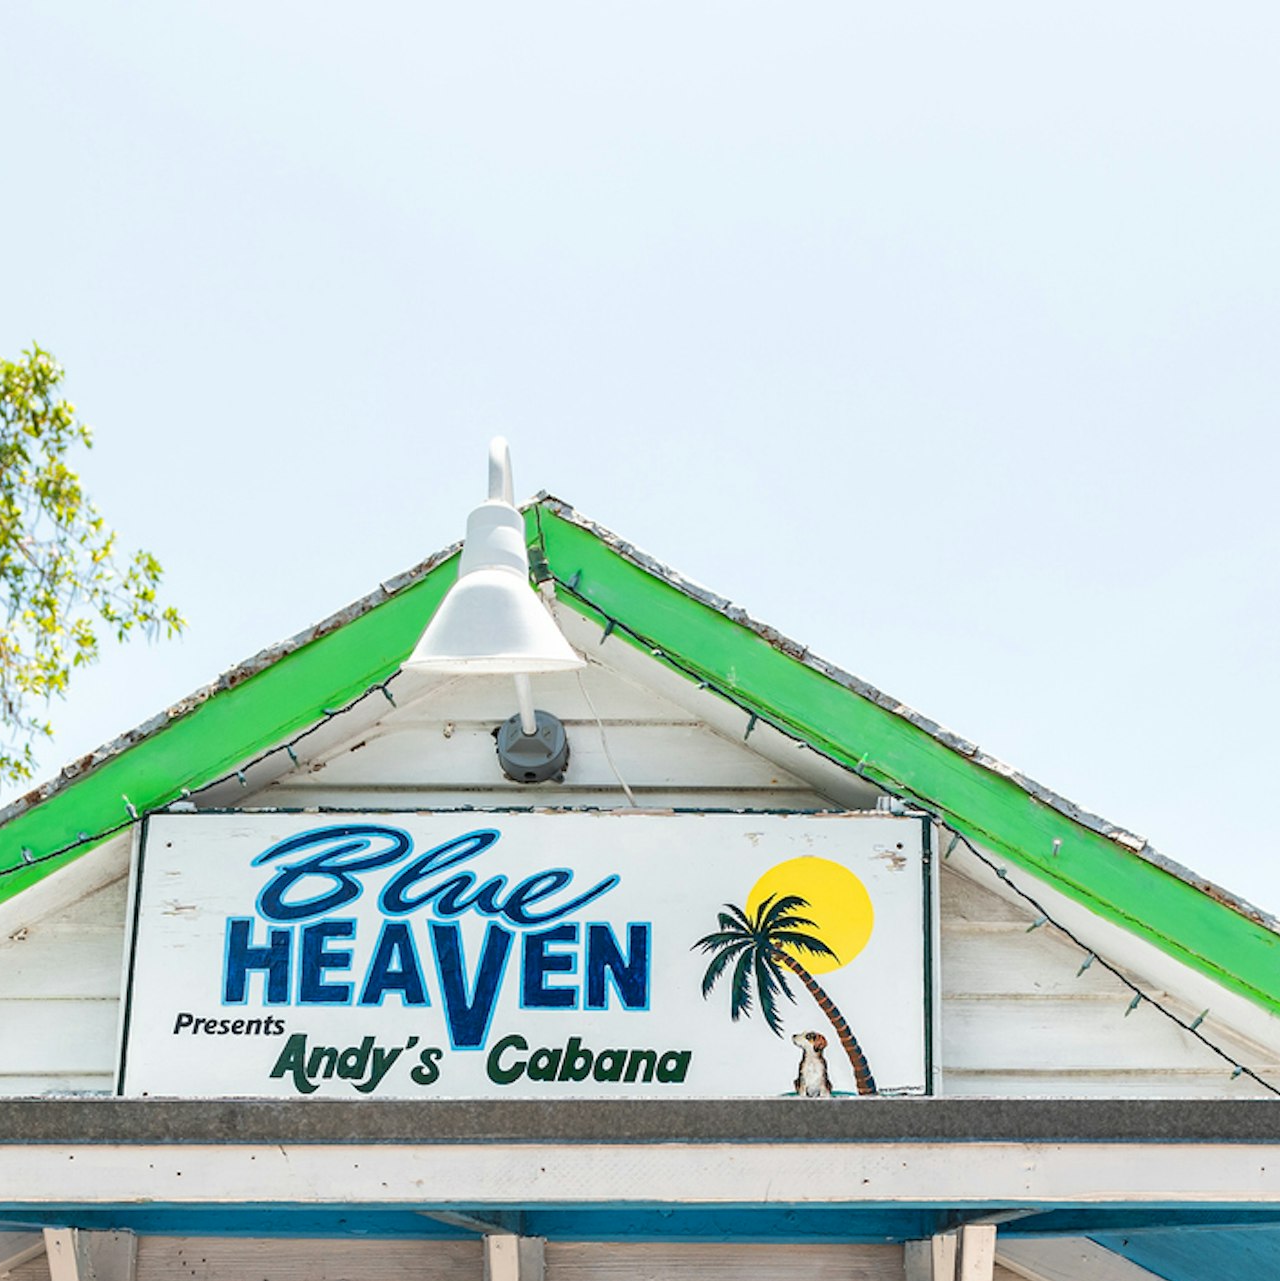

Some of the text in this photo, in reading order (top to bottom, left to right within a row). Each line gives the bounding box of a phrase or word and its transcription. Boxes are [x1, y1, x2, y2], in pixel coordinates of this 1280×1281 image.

[250, 824, 620, 928] Blue
[221, 915, 653, 1051] HEAVEN
[173, 1013, 285, 1036] Presents
[270, 1033, 692, 1094] Andy's Cabana
